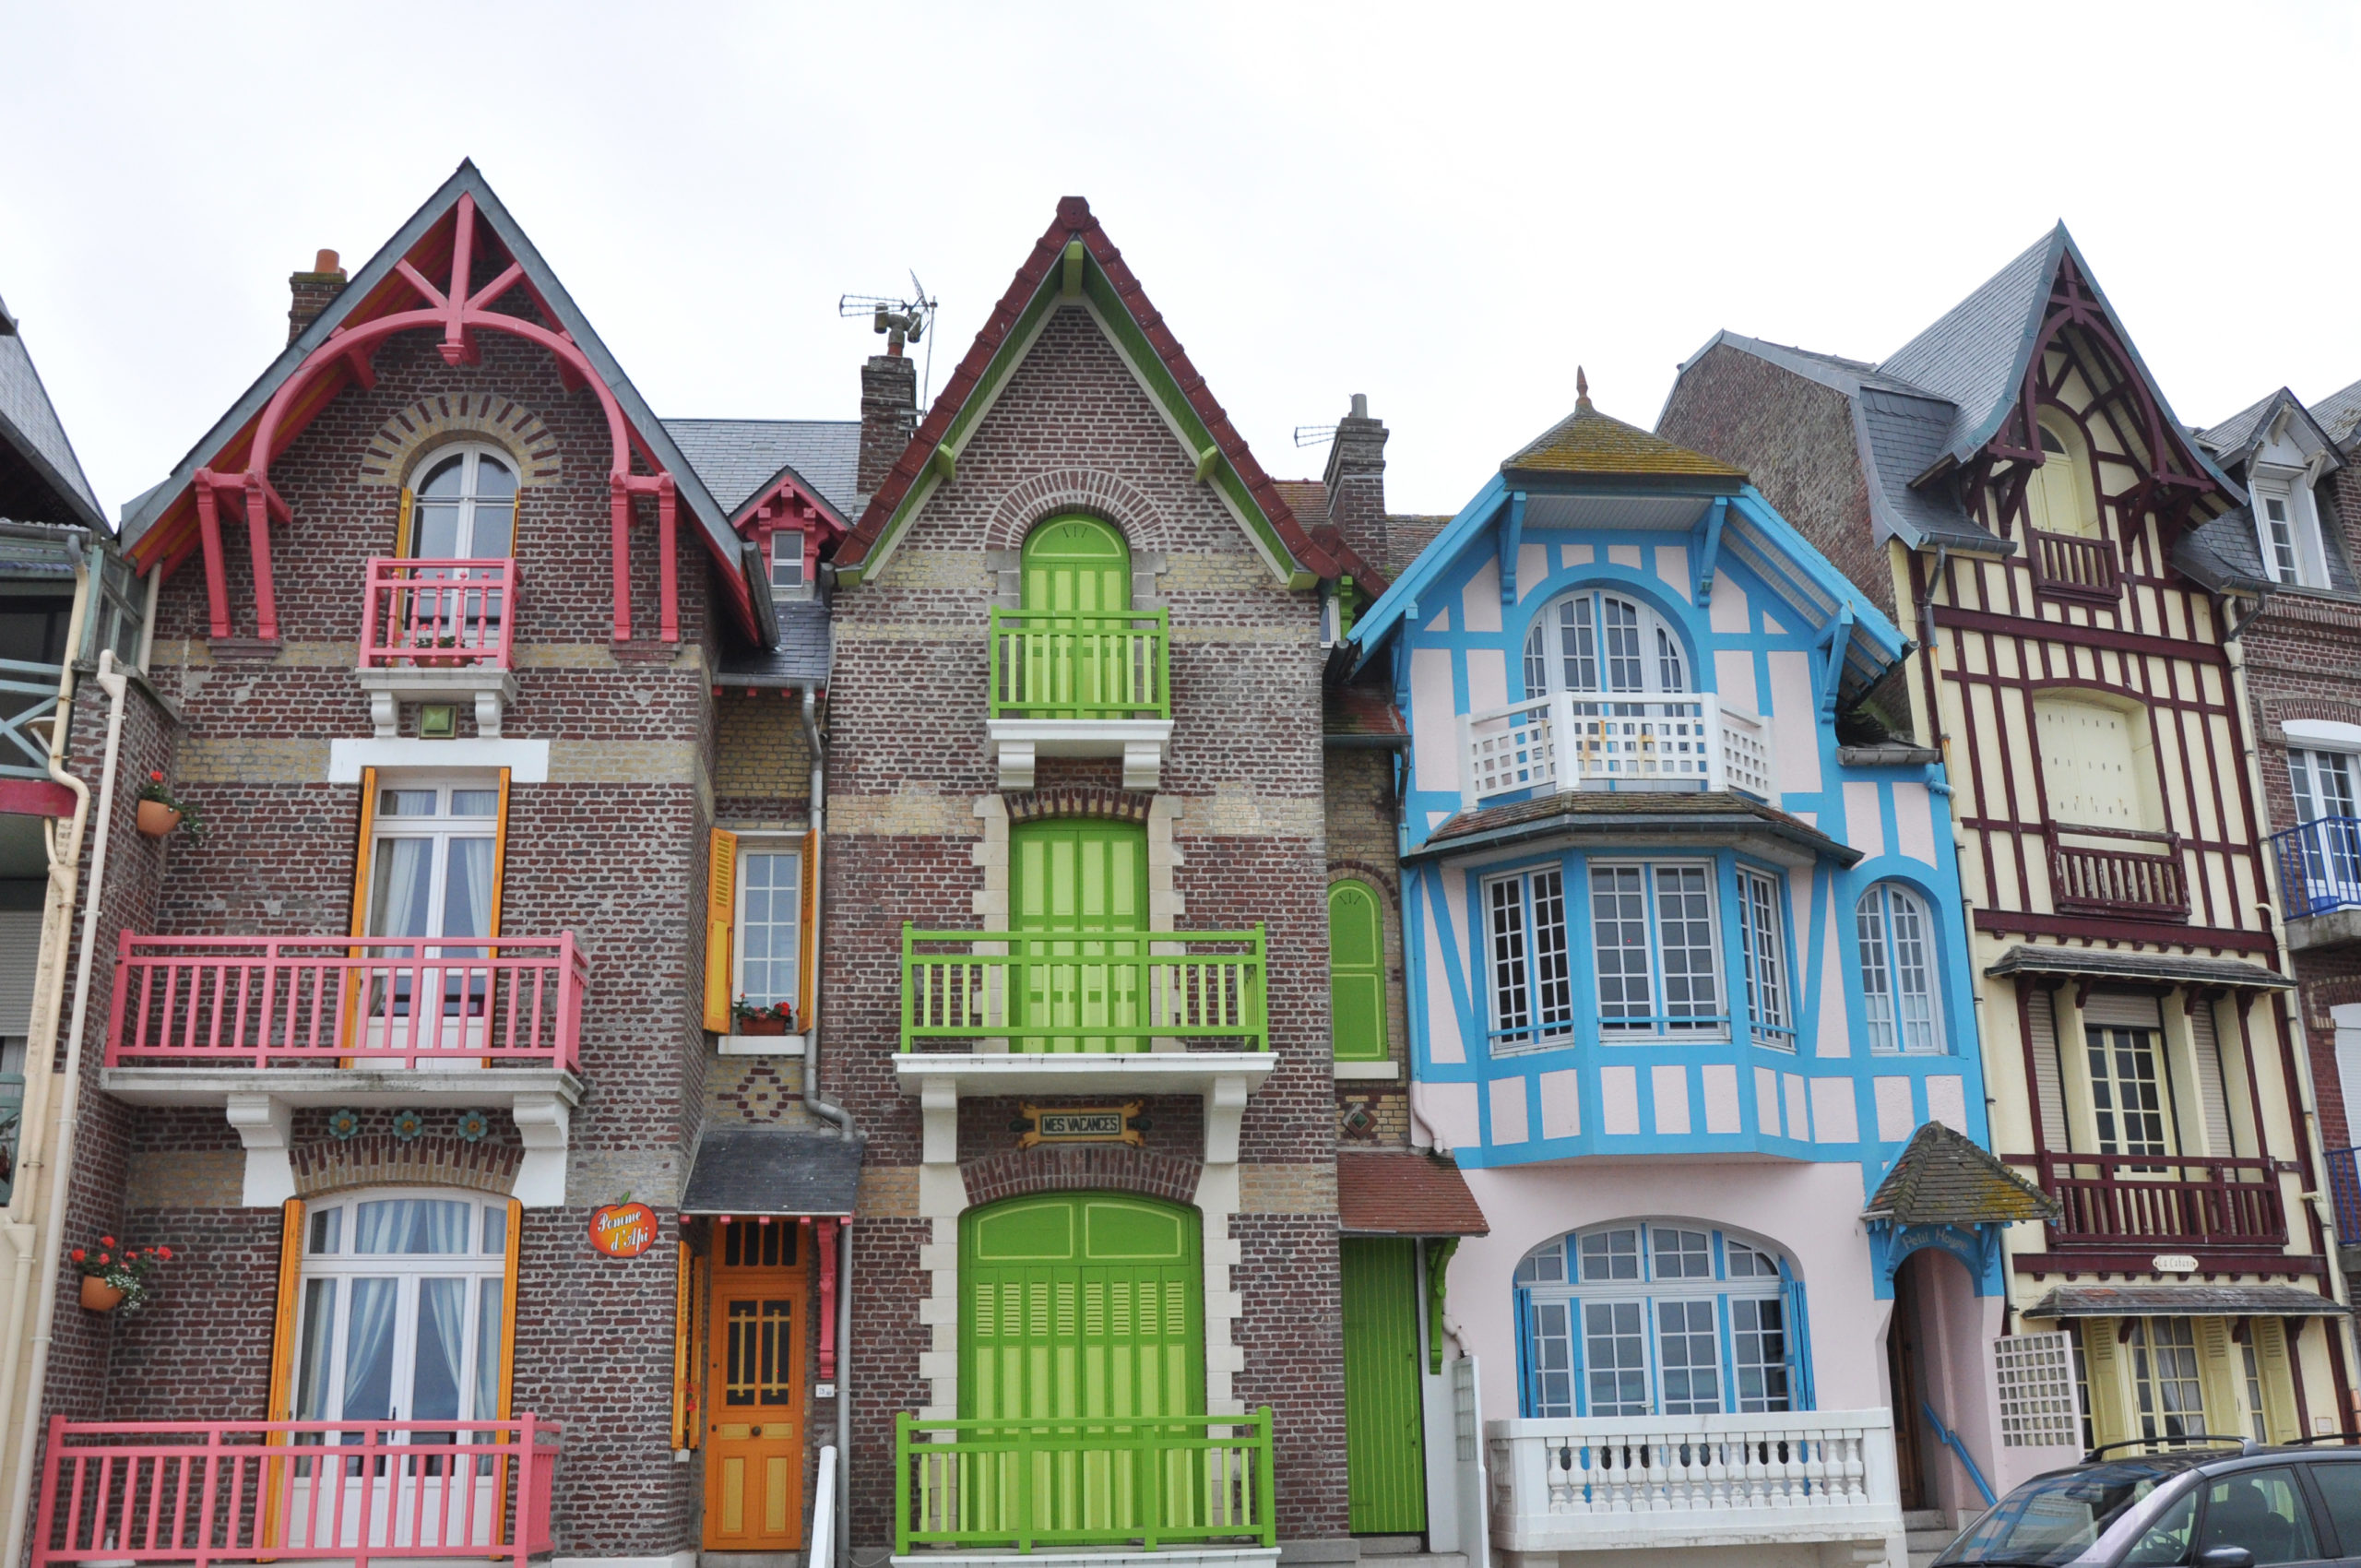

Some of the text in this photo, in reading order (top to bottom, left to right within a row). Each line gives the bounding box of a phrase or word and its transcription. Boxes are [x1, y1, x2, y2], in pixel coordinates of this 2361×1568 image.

[1044, 1116, 1118, 1132] MES VACANCES
[597, 1210, 642, 1232] Pomme
[611, 1225, 649, 1252] d'Api
[1902, 1231, 1930, 1250] Petit
